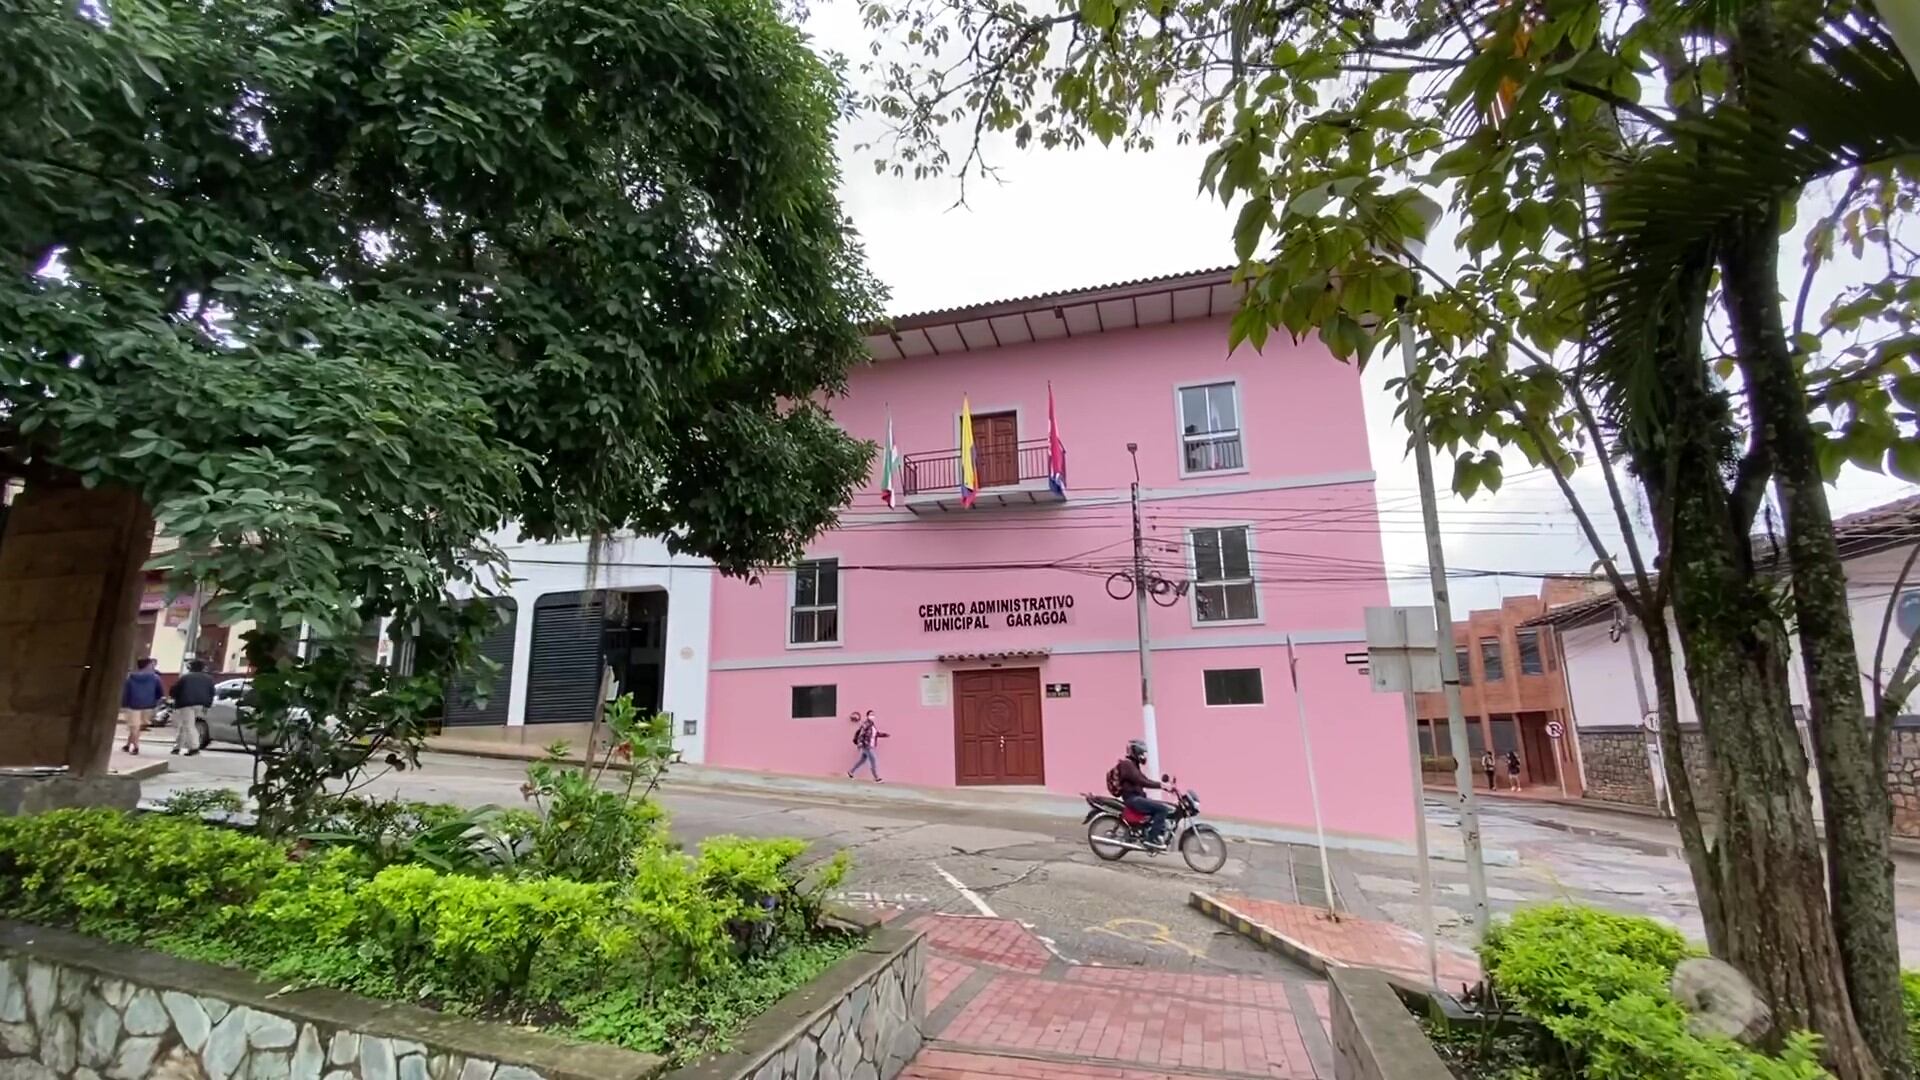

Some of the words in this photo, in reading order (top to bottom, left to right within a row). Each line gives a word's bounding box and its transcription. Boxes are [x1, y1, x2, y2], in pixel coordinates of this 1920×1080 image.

[918, 602, 965, 618] CENTRO
[969, 594, 1074, 615] ADMINISTRATIVO
[924, 615, 989, 632] MUNICIPAL
[1006, 610, 1067, 627] GARAGOA
